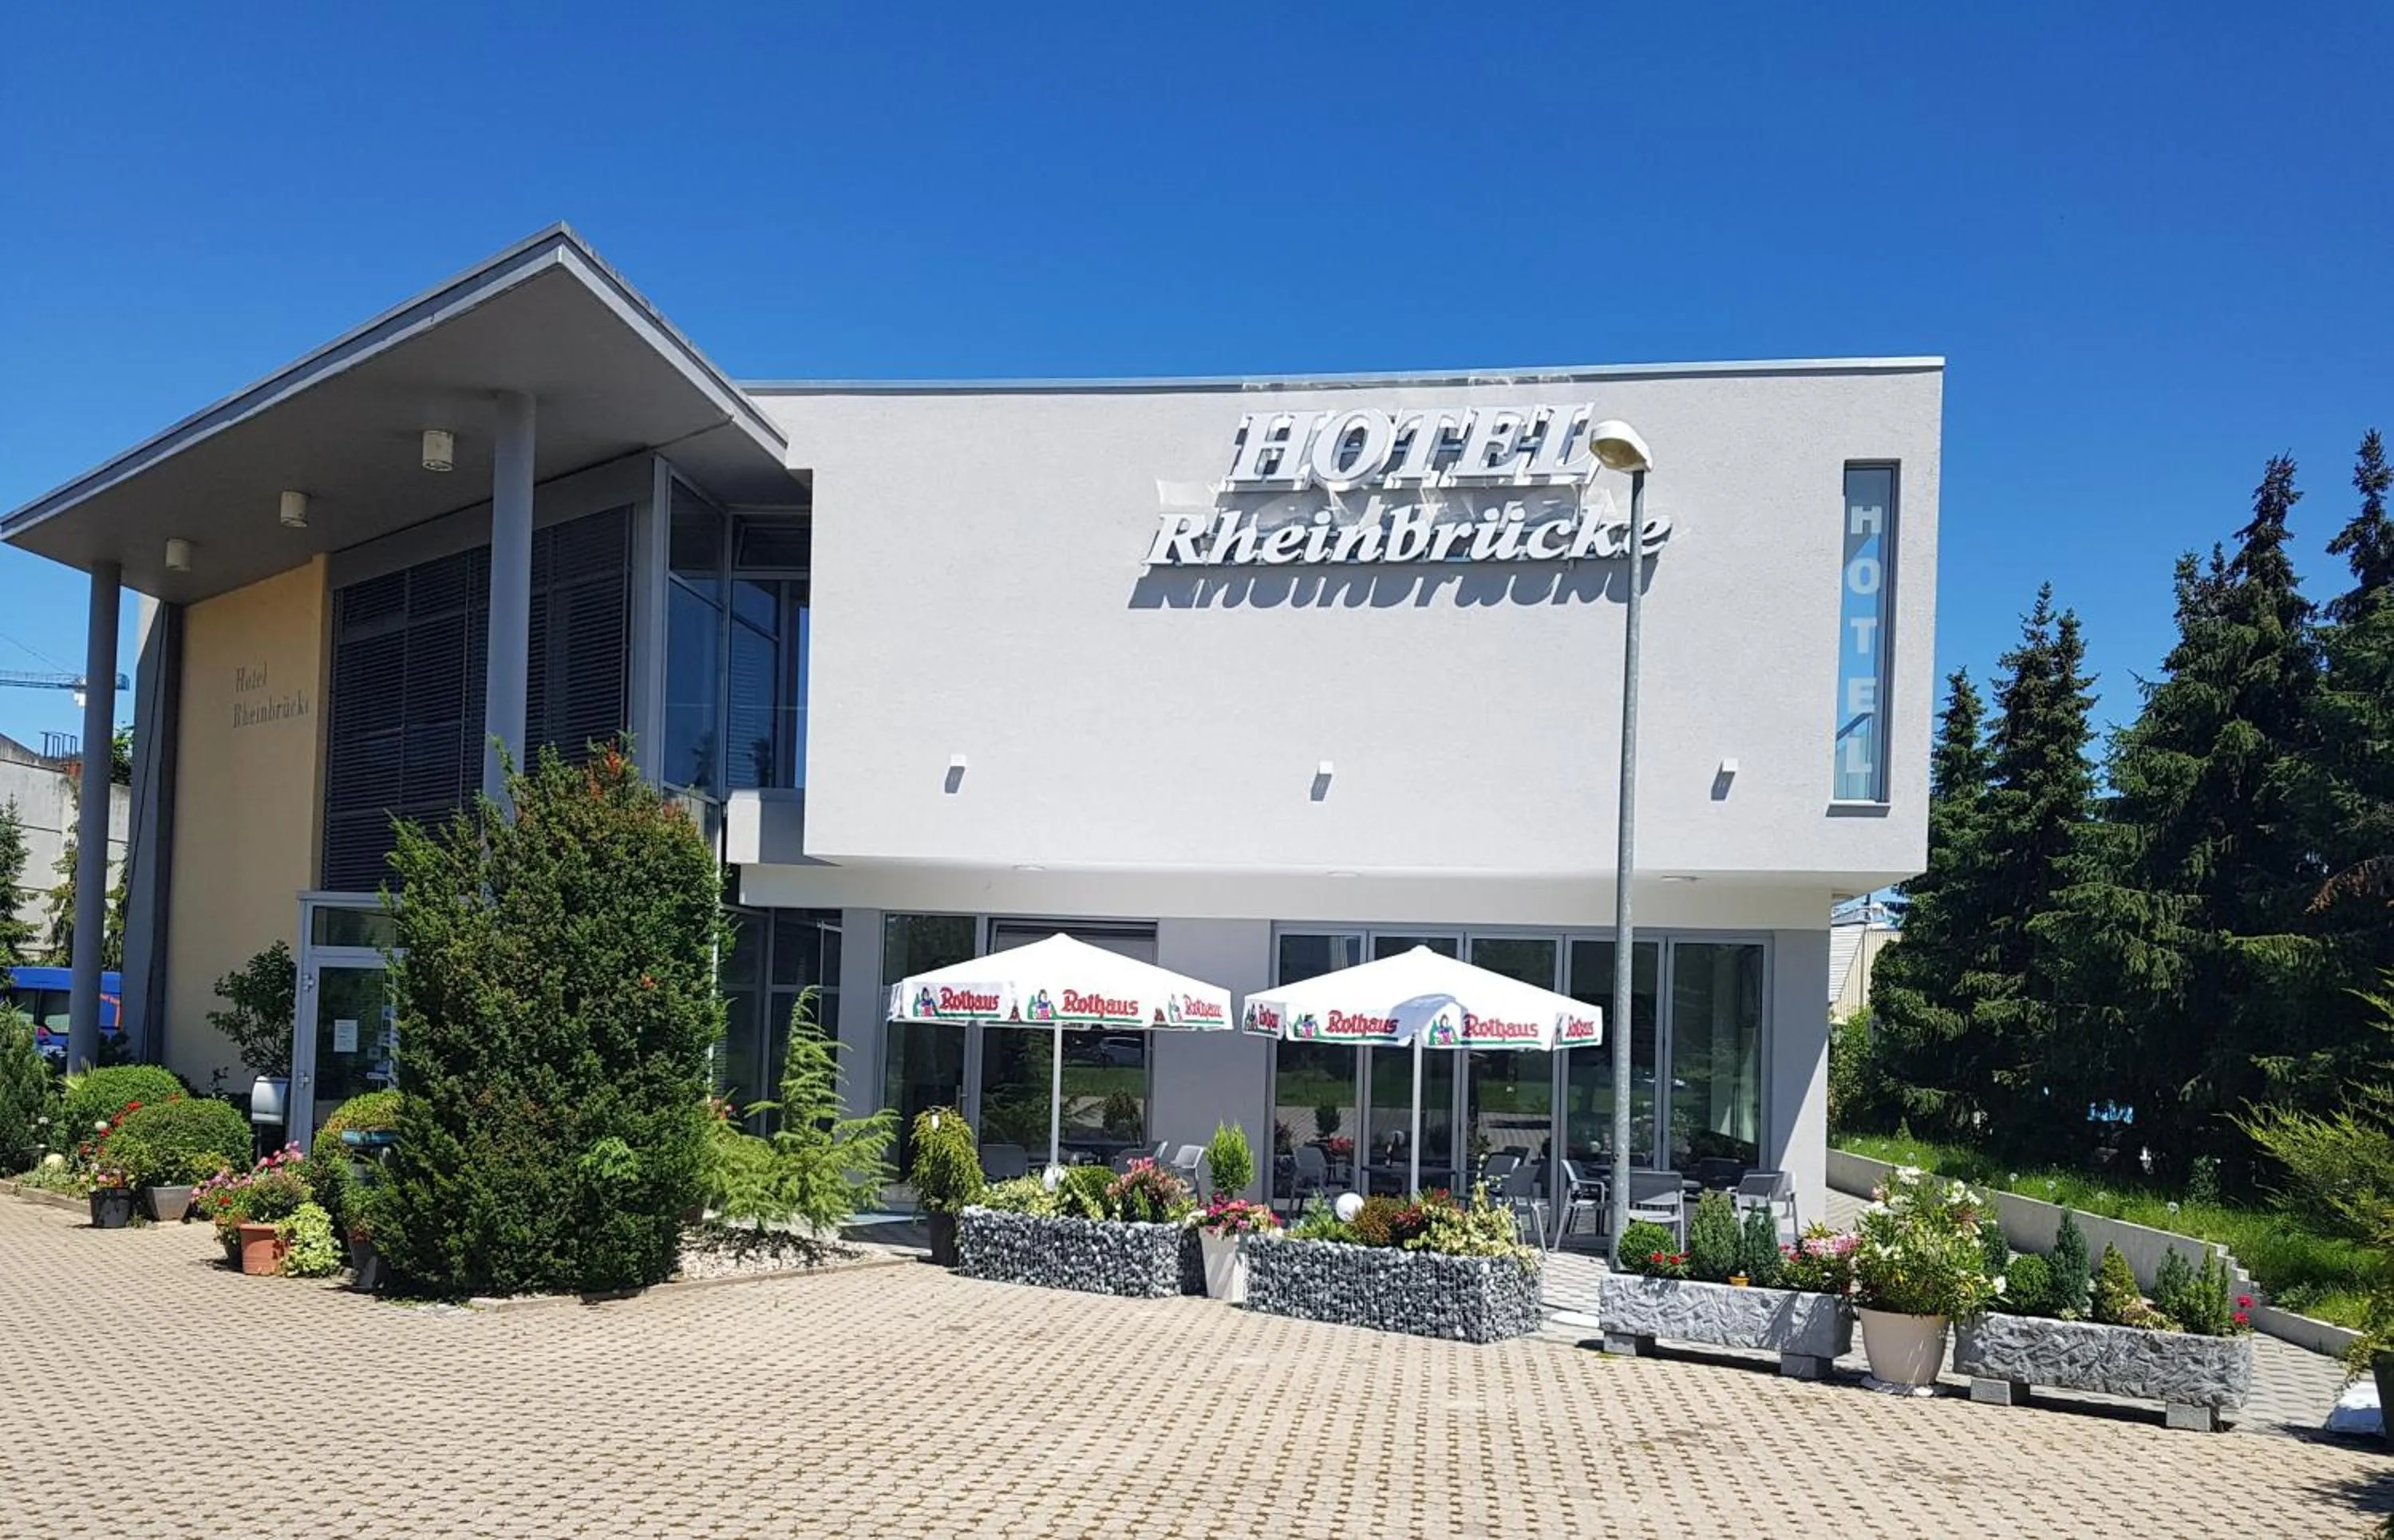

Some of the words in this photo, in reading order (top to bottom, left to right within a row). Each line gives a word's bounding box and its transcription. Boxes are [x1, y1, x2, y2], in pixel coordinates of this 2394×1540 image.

[1223, 403, 1601, 492] HOTEL
[1146, 504, 1673, 565] Rheinbrücke
[1846, 505, 1882, 774] HOTEL
[939, 986, 1000, 1015] Rothaus
[1061, 989, 1139, 1018] Rothaus
[1325, 1009, 1399, 1037] Rothaus
[1462, 1013, 1539, 1042] Rothaus
